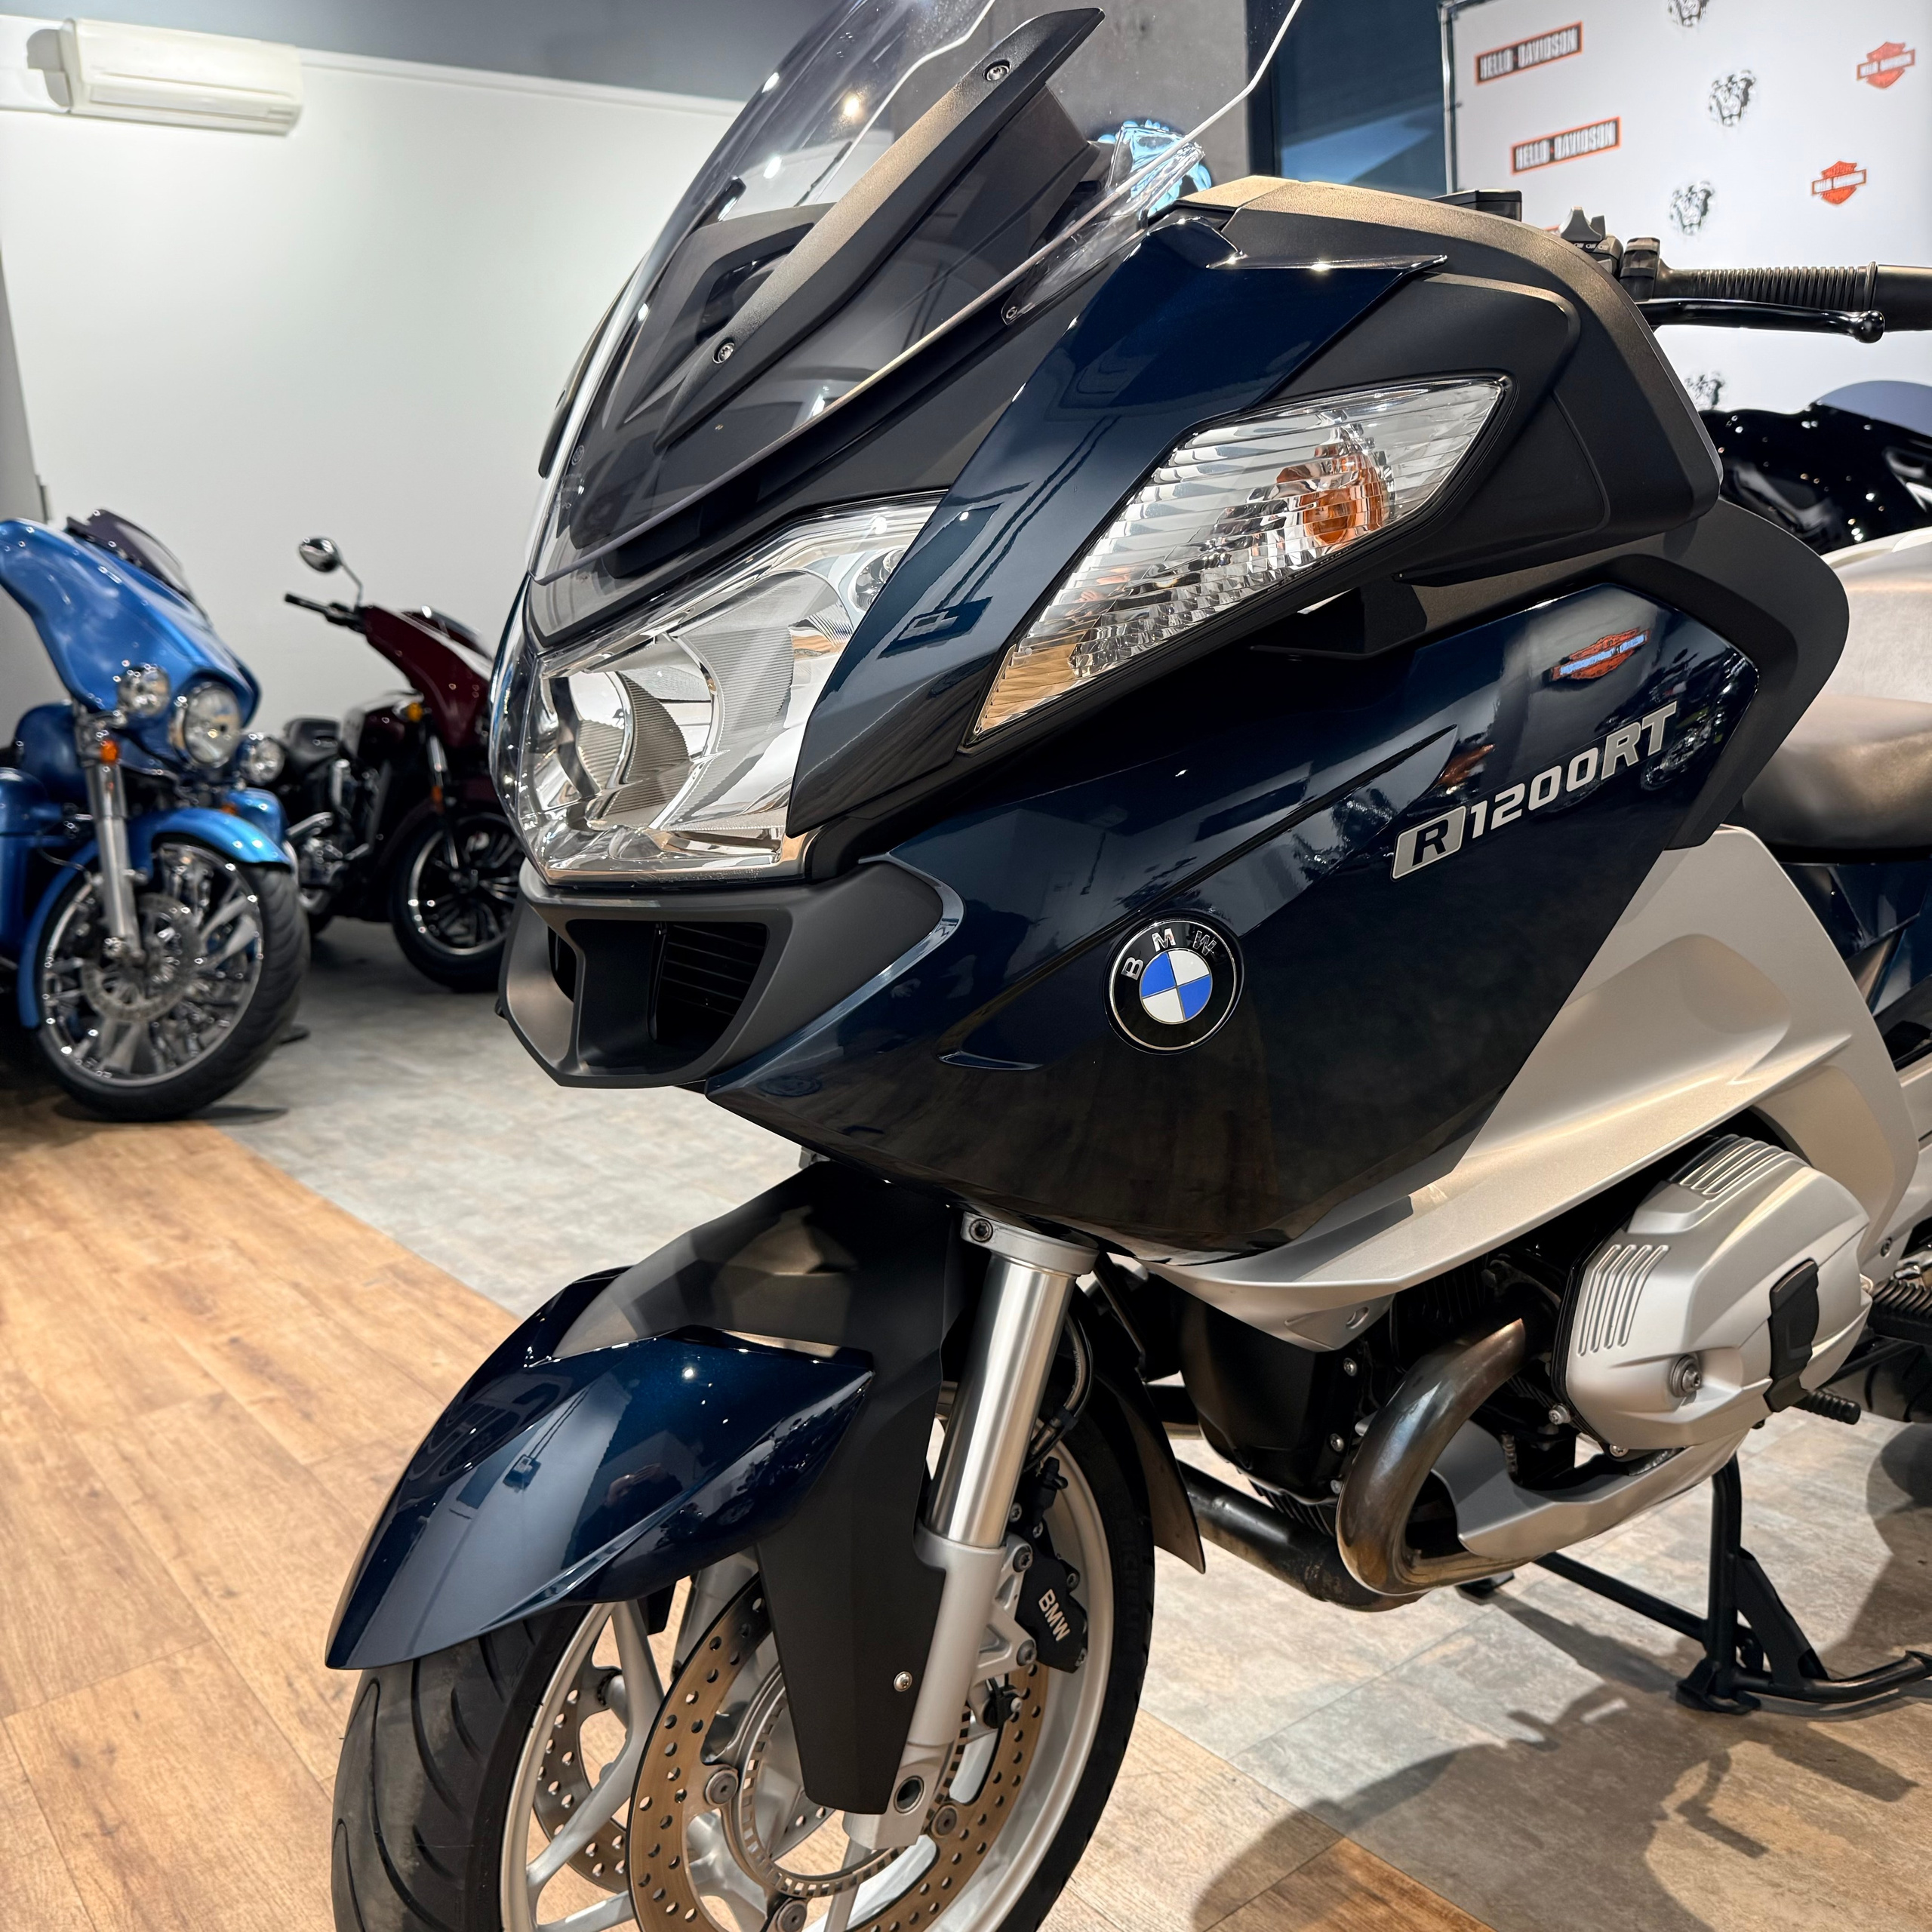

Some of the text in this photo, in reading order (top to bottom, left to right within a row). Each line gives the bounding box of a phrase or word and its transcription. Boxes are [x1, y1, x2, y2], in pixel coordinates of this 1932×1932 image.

[1517, 26, 1579, 69] DAVIDSON
[1554, 120, 1617, 161] DAVIDSON
[1121, 928, 1217, 981] BMW
[1038, 1589, 1070, 1641] BMW
